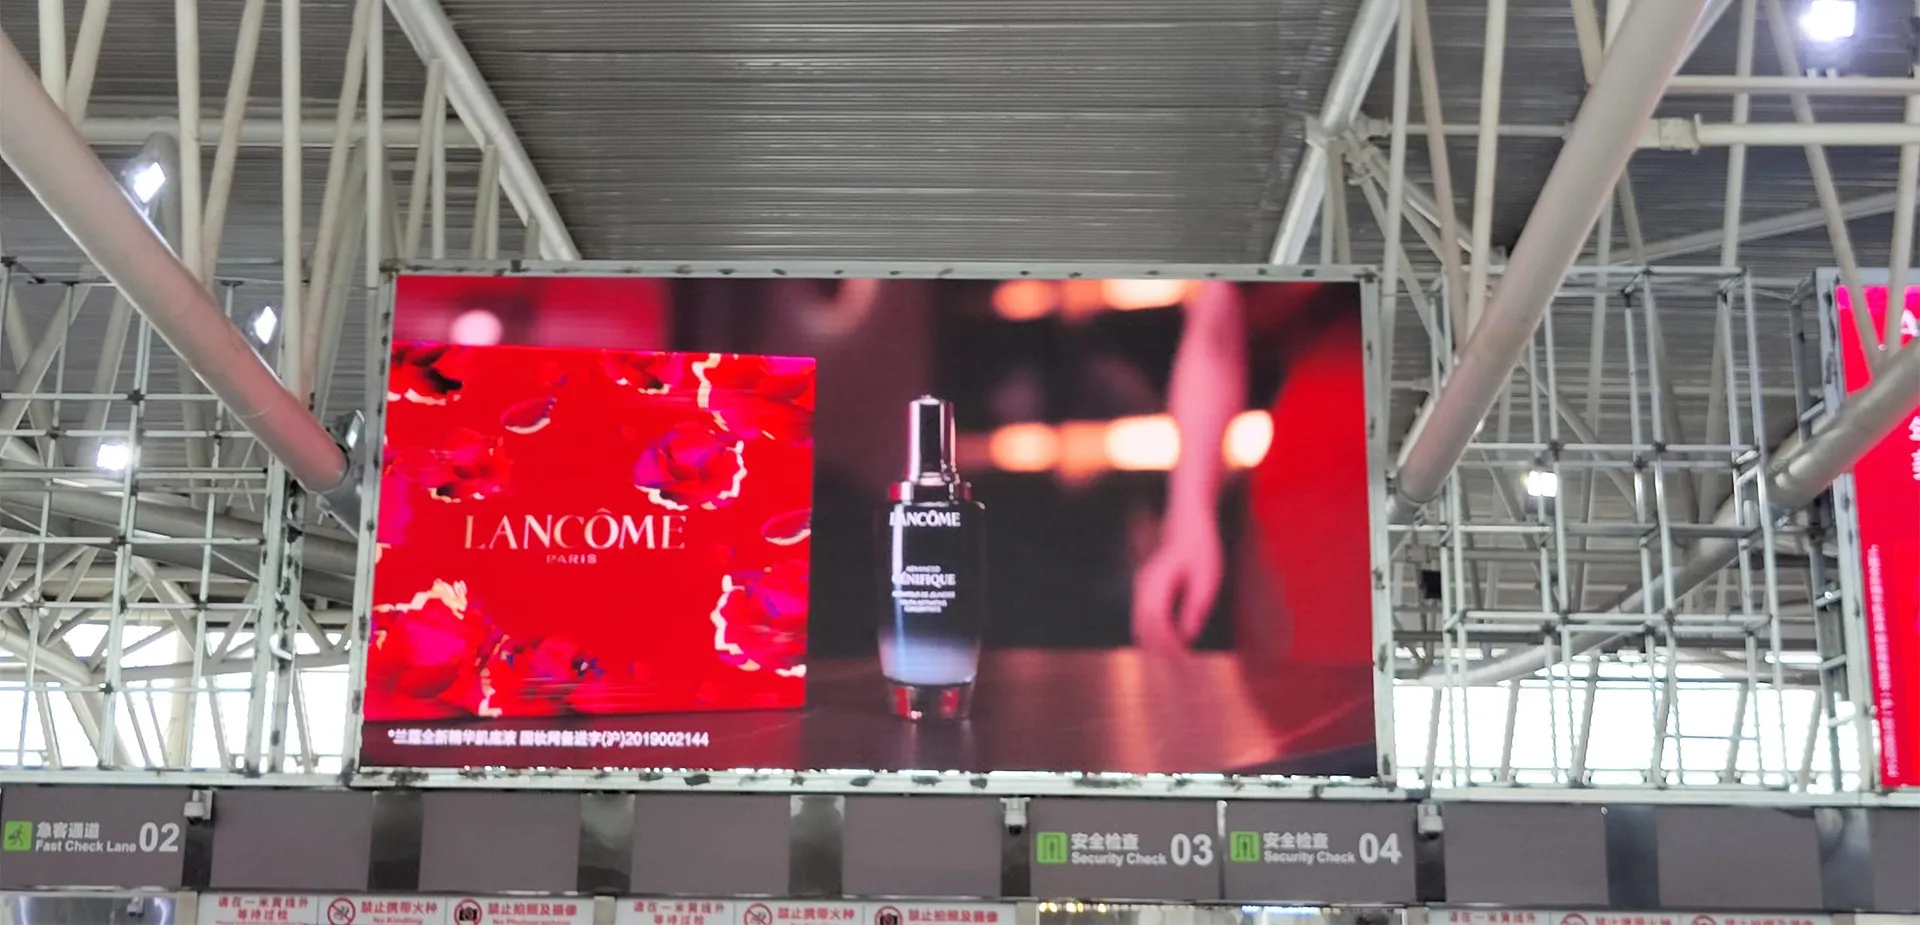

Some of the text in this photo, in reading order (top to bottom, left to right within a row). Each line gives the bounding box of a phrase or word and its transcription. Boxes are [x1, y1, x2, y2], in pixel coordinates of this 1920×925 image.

[889, 509, 961, 527] LANCÔME
[464, 507, 686, 550] LANCÔME
[546, 553, 597, 564] PARIS
[36, 821, 100, 839] 急客通道
[139, 822, 180, 852] 02
[35, 840, 136, 852] Fast Check Lane
[1071, 832, 1139, 850] 安全检查
[1170, 833, 1214, 866] 03
[1263, 832, 1329, 849] 安全检查
[1358, 832, 1402, 865] 04
[1071, 852, 1167, 867] Security Check
[1263, 850, 1356, 865] Security Check
